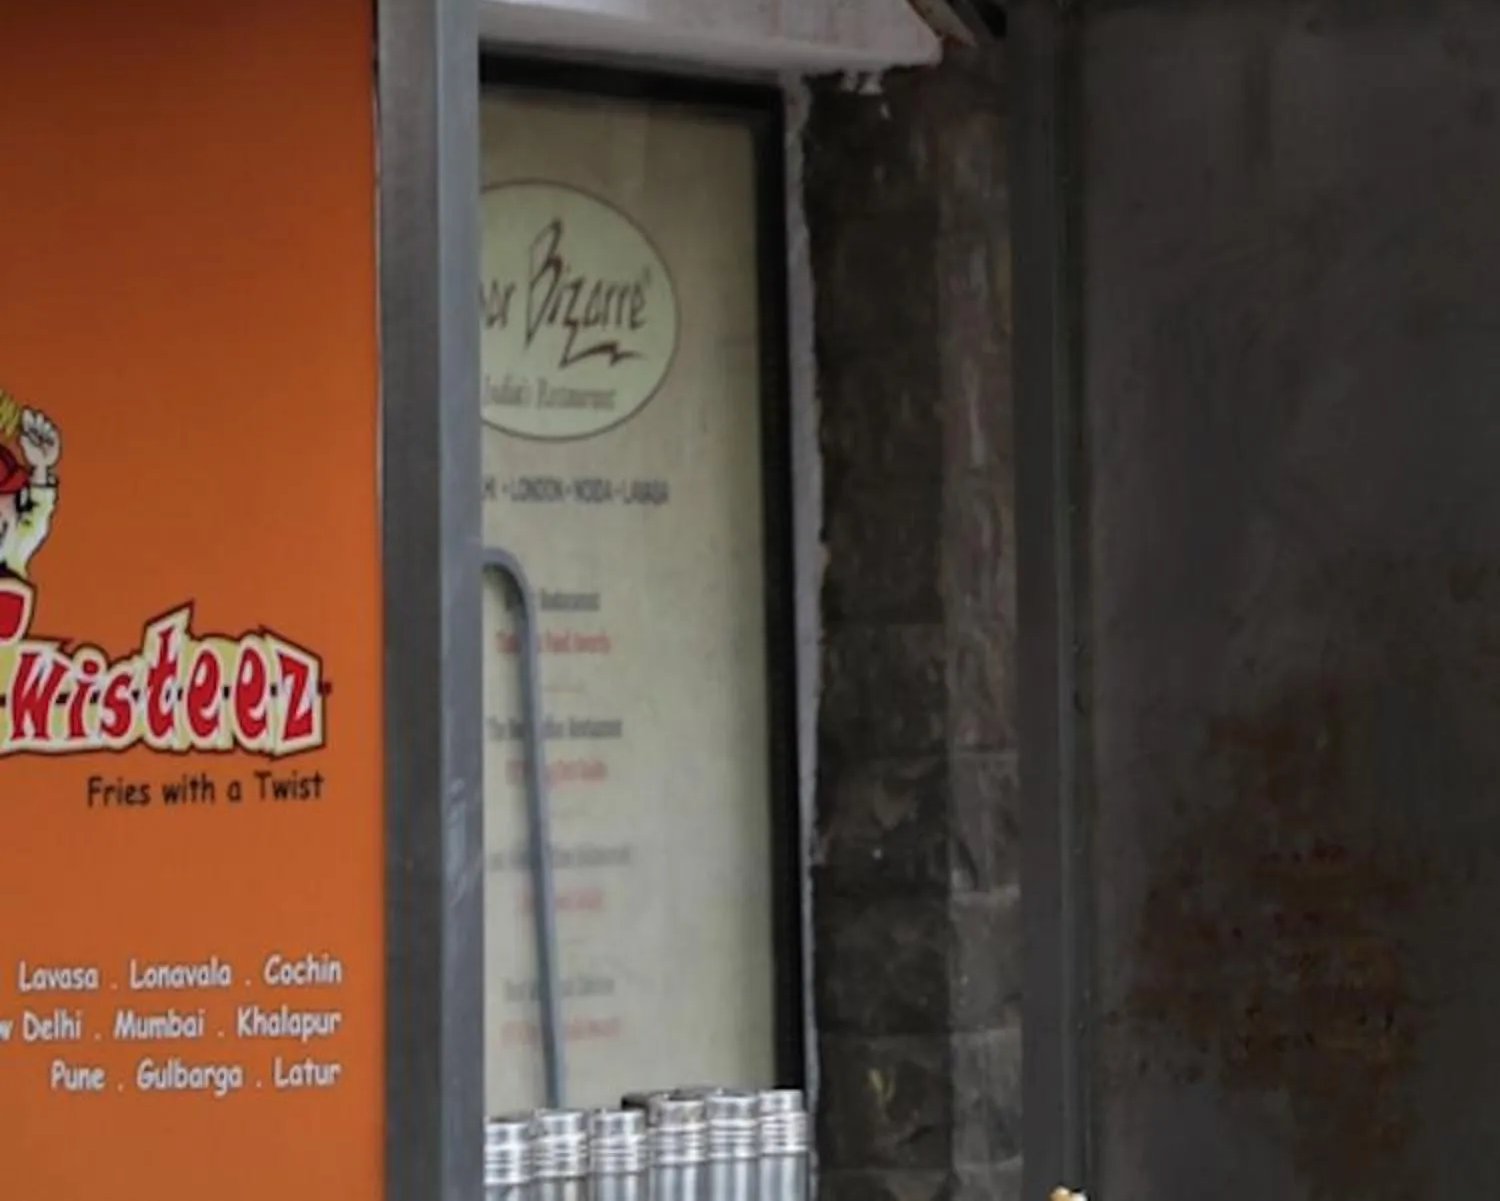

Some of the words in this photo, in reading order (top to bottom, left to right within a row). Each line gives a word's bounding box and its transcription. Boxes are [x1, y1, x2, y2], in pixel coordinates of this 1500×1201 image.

[0, 589, 314, 742] wisteez
[87, 776, 151, 808] Fries
[162, 773, 216, 804] with
[227, 783, 242, 802] a
[254, 770, 325, 802] Twist
[18, 960, 99, 992] Lavasa
[129, 956, 231, 989] Lonavala
[264, 952, 343, 985] Cochin
[22, 1009, 83, 1042] Delhi
[113, 1008, 205, 1040] Mumbai
[237, 1004, 342, 1043] Khalapur
[51, 1058, 105, 1090] Pune
[136, 1057, 243, 1097] Gulbarga
[273, 1056, 342, 1088] Latur
